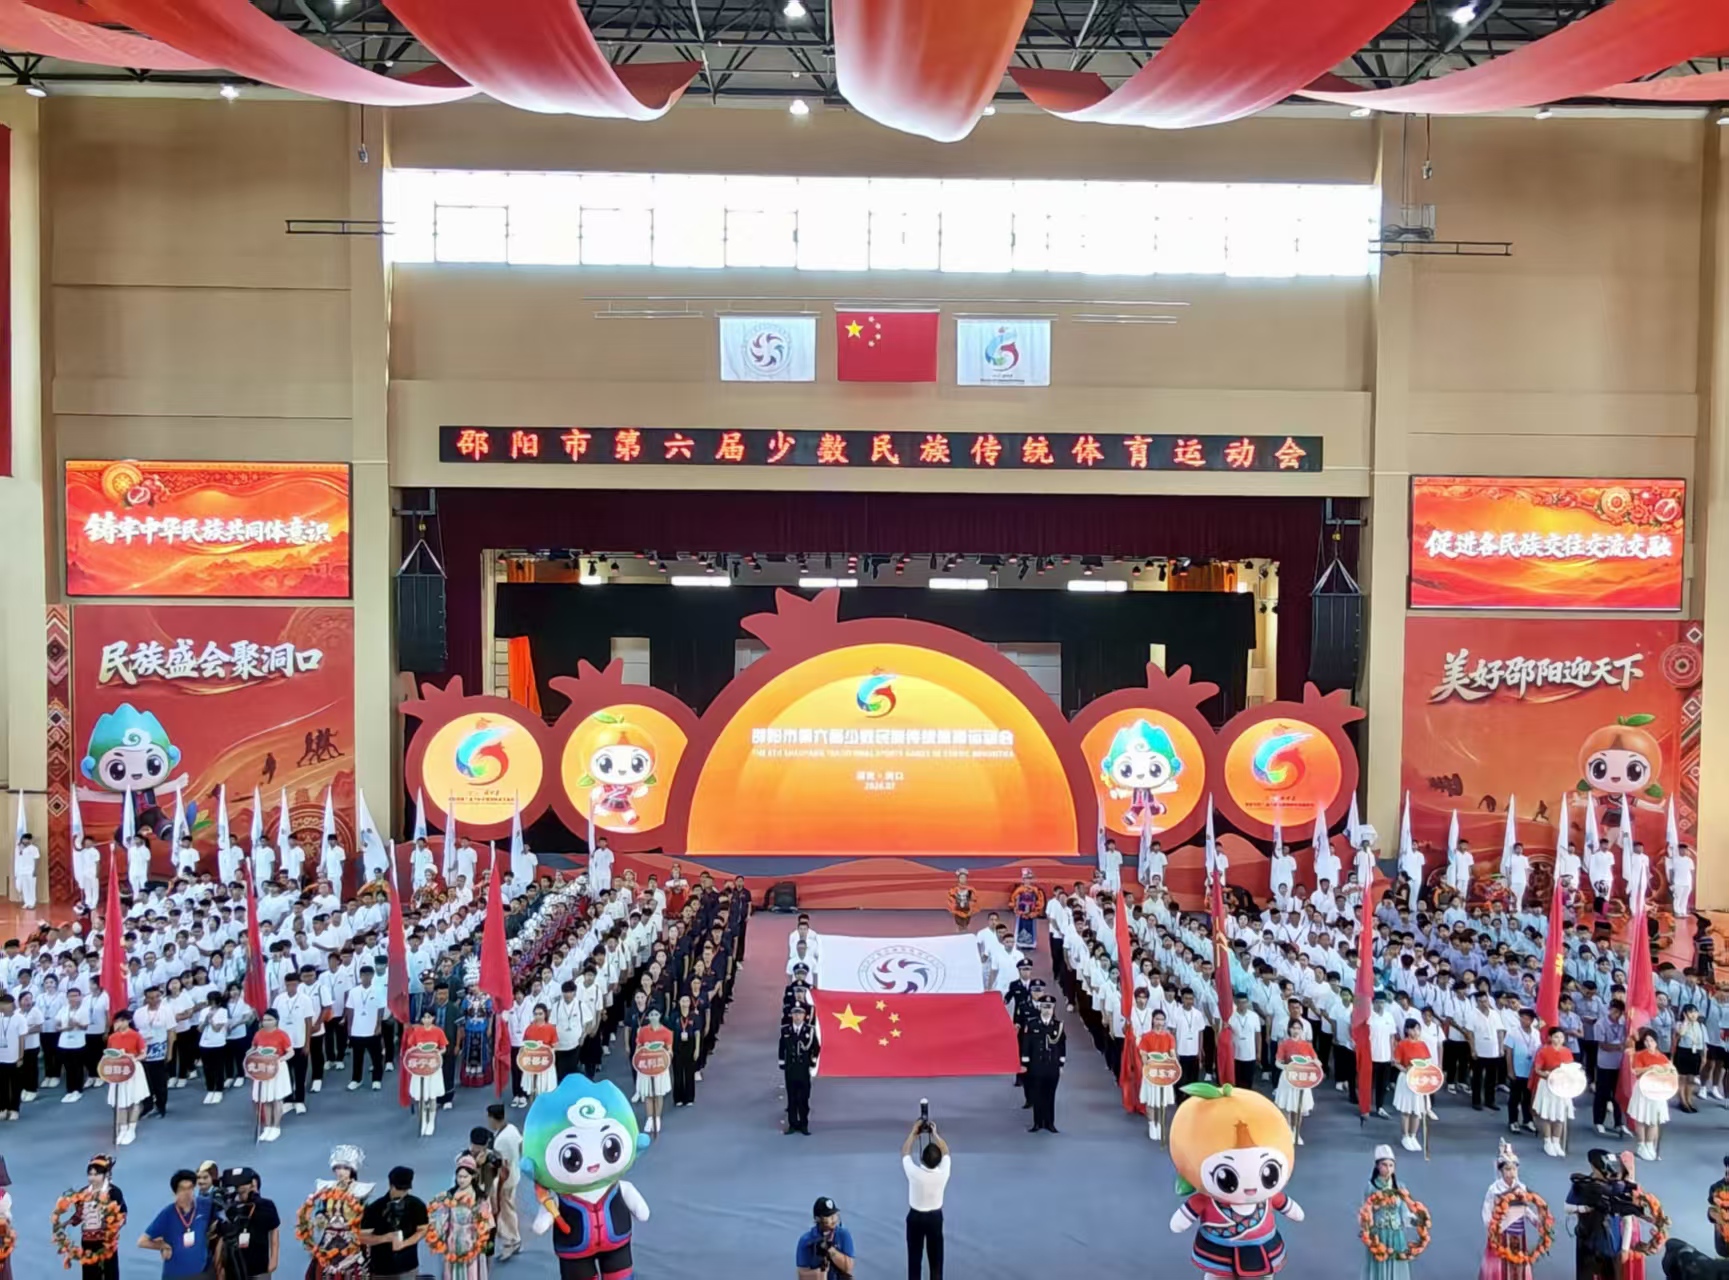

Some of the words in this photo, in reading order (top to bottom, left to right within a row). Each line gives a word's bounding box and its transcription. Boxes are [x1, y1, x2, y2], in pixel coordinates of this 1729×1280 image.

[457, 428, 1307, 469] 邵阳市第六届少数民族传统体育运动会
[84, 511, 332, 544] 铸牢中华民族共同体意识
[1424, 529, 1673, 559] 促进各民族交往交流交融
[98, 638, 324, 686] 民族盛会聚洞口
[1427, 648, 1645, 704] 美好邵阳迎天下
